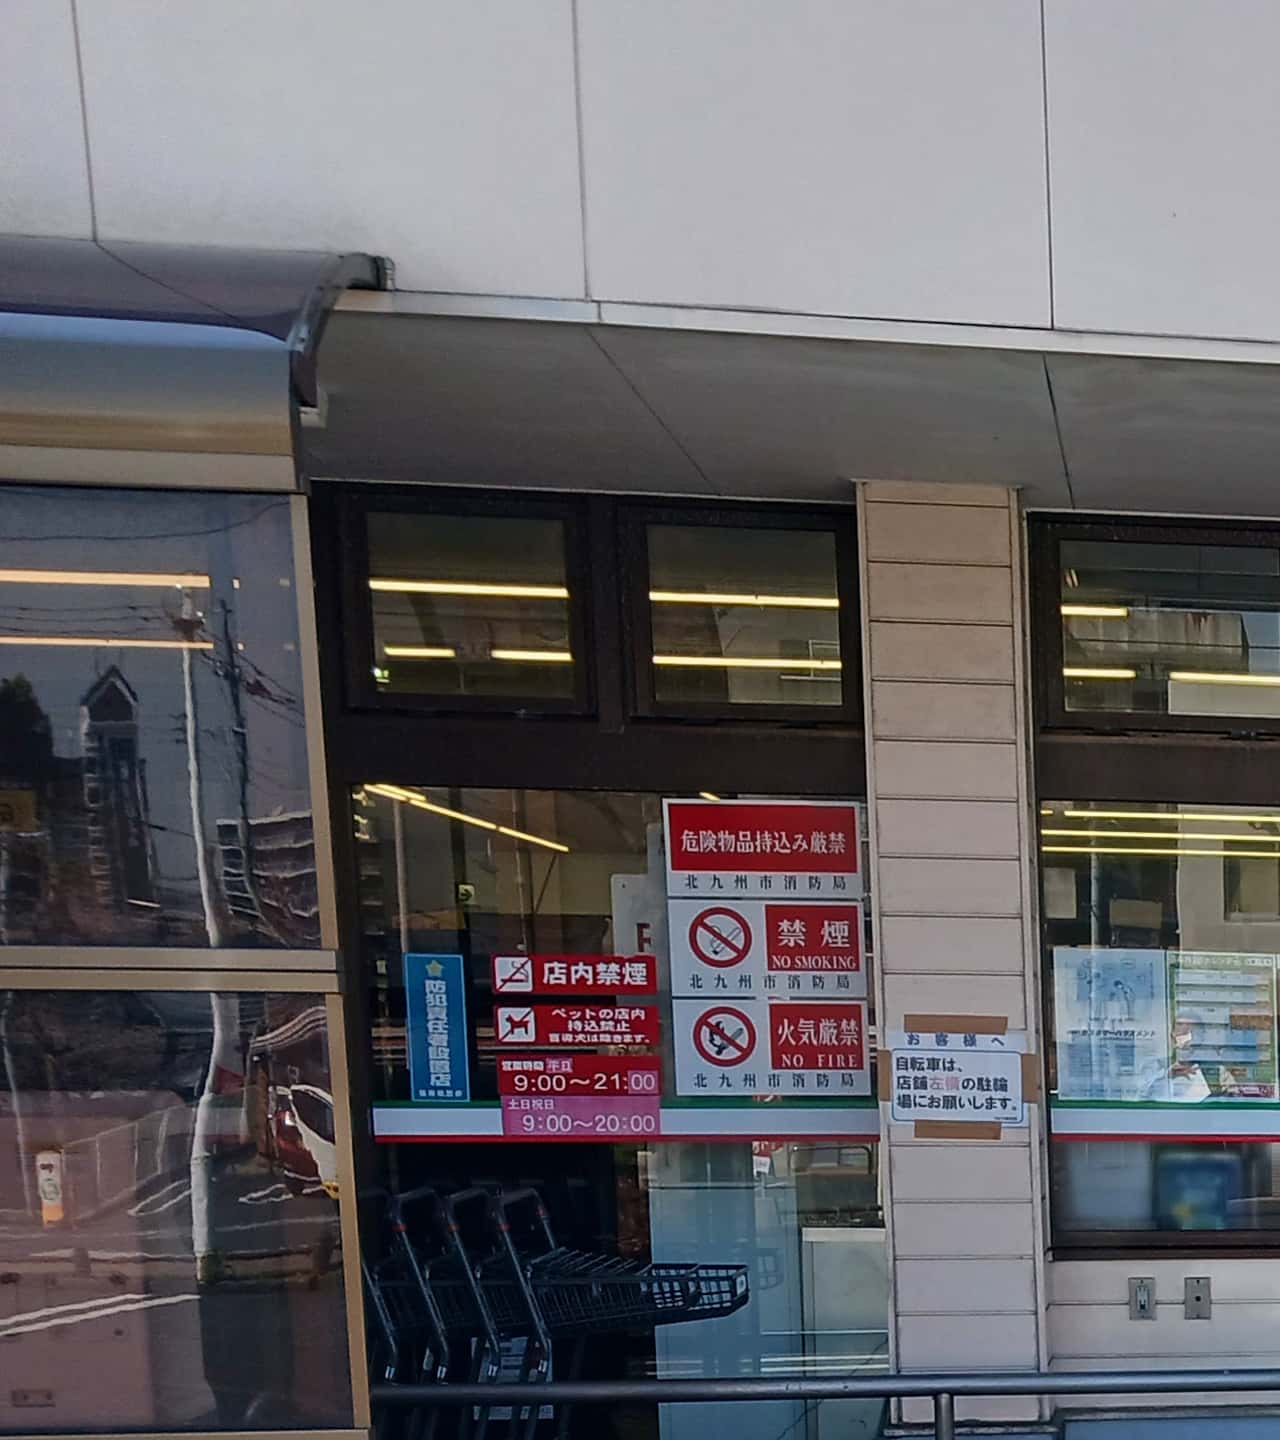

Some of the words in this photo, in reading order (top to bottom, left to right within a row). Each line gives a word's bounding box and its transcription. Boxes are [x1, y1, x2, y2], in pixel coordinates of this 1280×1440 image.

[680, 829, 847, 854] 危険物品持込み厳禁
[685, 874, 846, 890] 北九州市消防局
[777, 919, 851, 947] 禁煙
[771, 955, 791, 969] NO
[794, 955, 857, 970] SMOKING
[543, 962, 648, 985] 店内禁煙
[689, 973, 850, 990] 北九州市消防局
[551, 1008, 646, 1021] ペットの店内
[567, 1020, 631, 1033] 持込禁止
[777, 1018, 860, 1047] 火気厳禁
[781, 1054, 804, 1067] NO
[818, 1054, 858, 1068] FIRE
[896, 1056, 963, 1072] 自転車は、
[693, 1072, 854, 1089] 北九州市消防局
[896, 1075, 1009, 1093] 店舗左横の駐輪
[507, 1099, 554, 1110] 土日祝日
[896, 1094, 1017, 1111] 場にお願いします。
